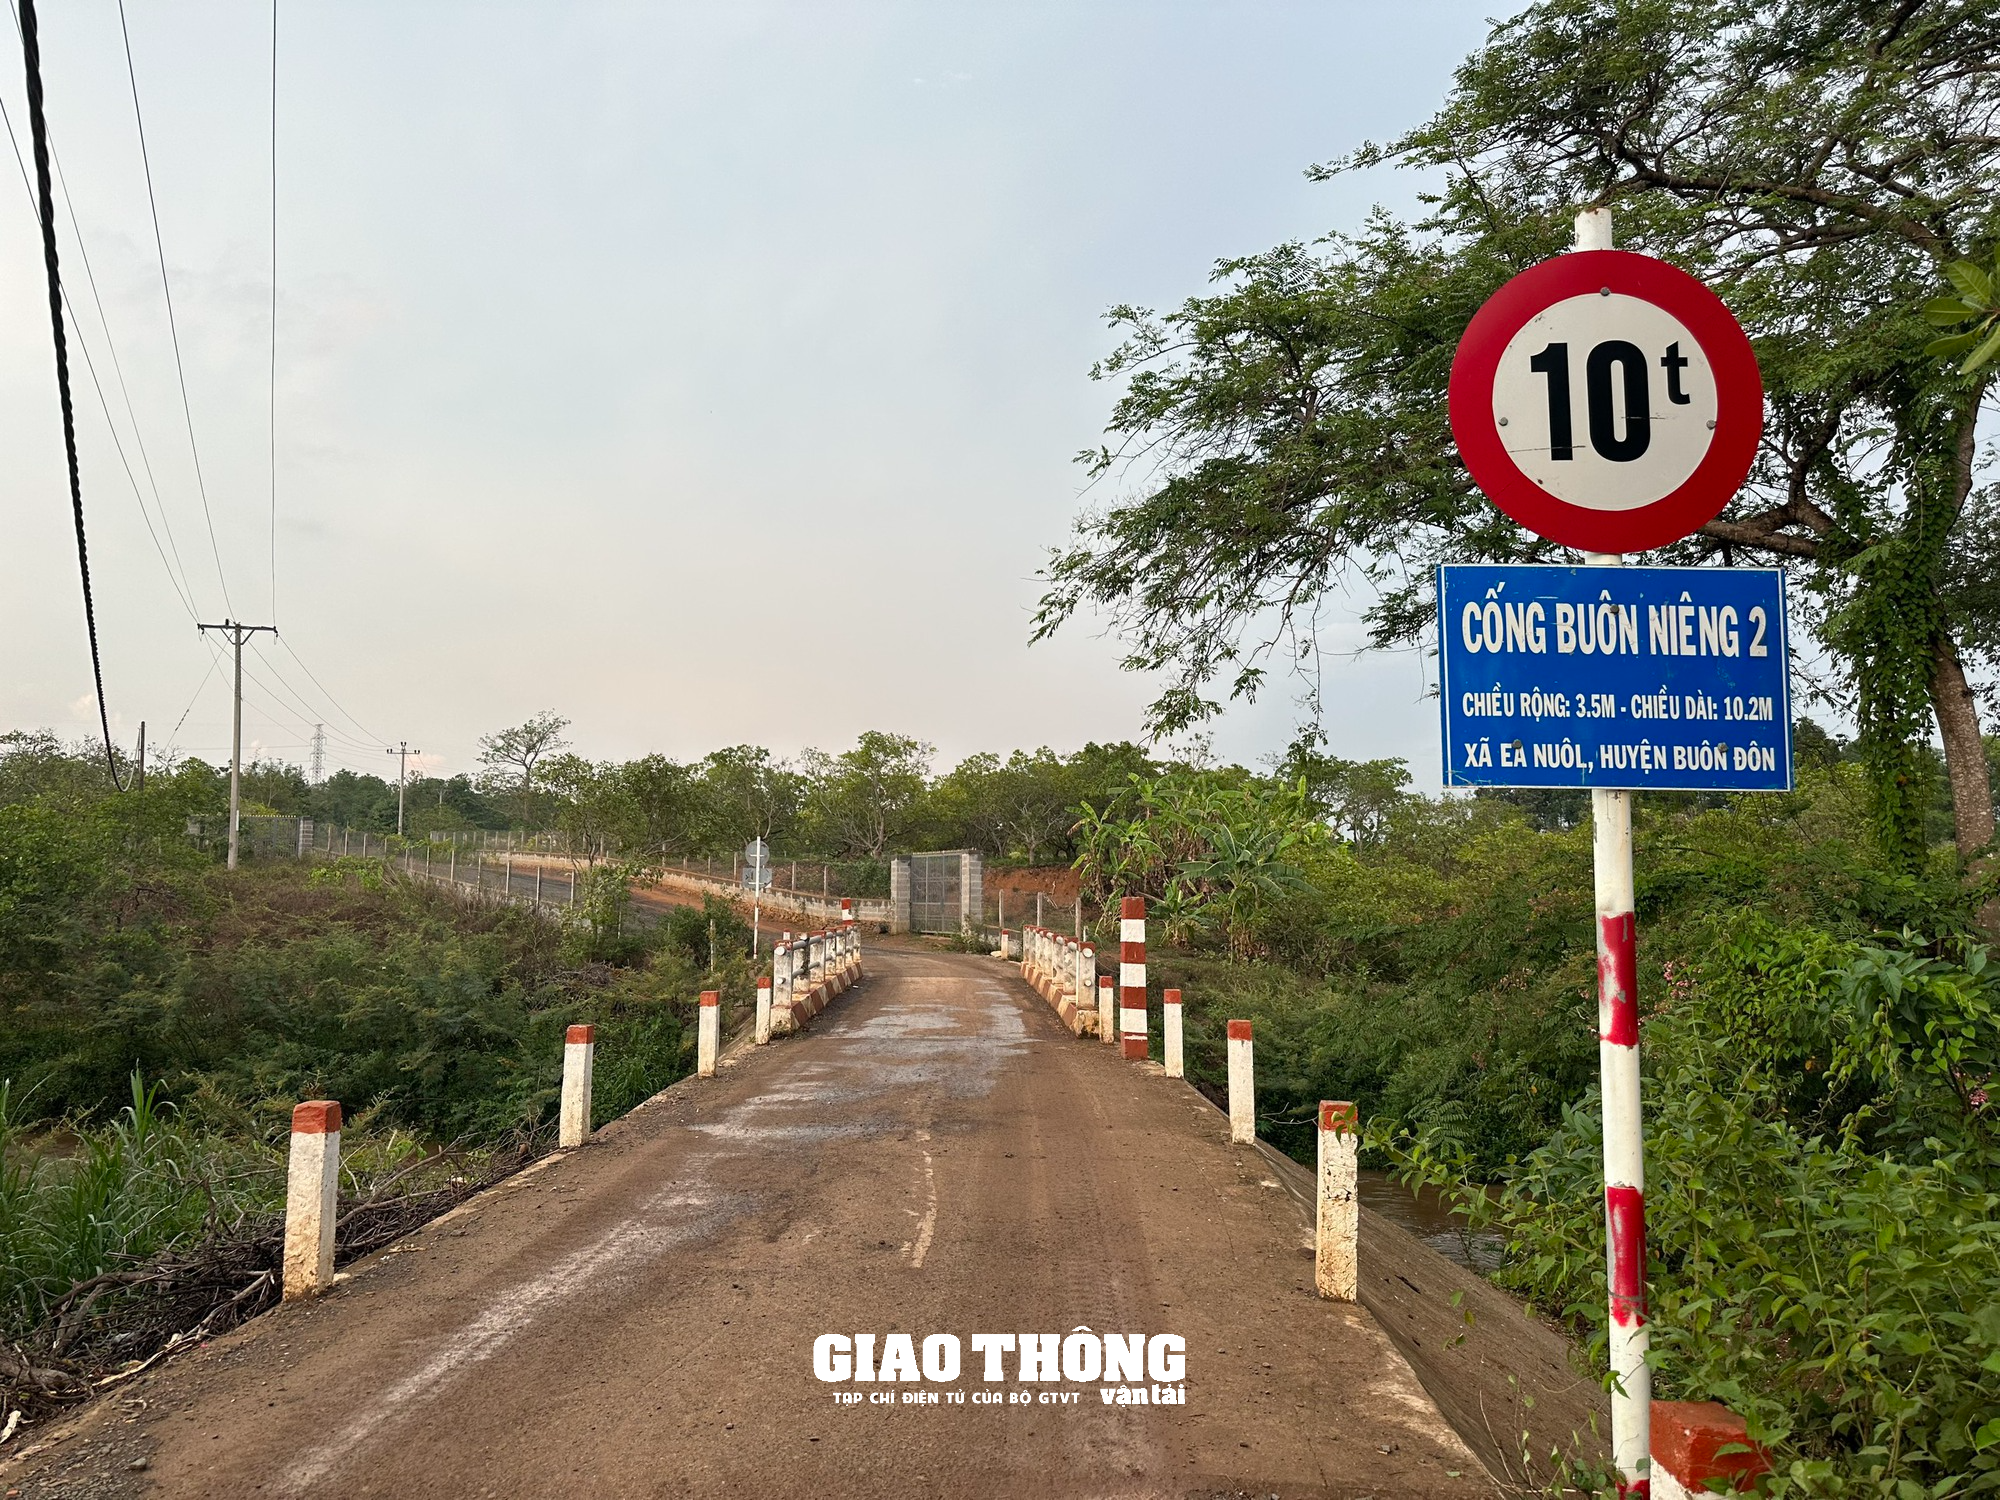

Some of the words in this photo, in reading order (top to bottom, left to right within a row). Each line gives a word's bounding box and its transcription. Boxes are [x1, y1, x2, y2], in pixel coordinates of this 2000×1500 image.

[1462, 581, 1547, 654] CỐNG
[1556, 589, 1638, 655] BUÔN
[1648, 591, 1740, 657] NIÊNG
[1748, 606, 1768, 657] 2
[1462, 682, 1514, 717] CHIỀU
[1520, 686, 1571, 722] RỘNG:
[1576, 693, 1616, 718] 3.5M
[1631, 684, 1680, 720] CHIỀU
[1685, 689, 1718, 720] DÀI:
[1724, 696, 1773, 721] 10.2M
[1464, 736, 1493, 768] XÃ
[1500, 743, 1528, 768] EA
[1533, 737, 1594, 774] NUÔL,
[1600, 738, 1667, 775] HUYỆN
[1673, 739, 1728, 771] BUÔN
[1733, 740, 1775, 772] ĐÔN
